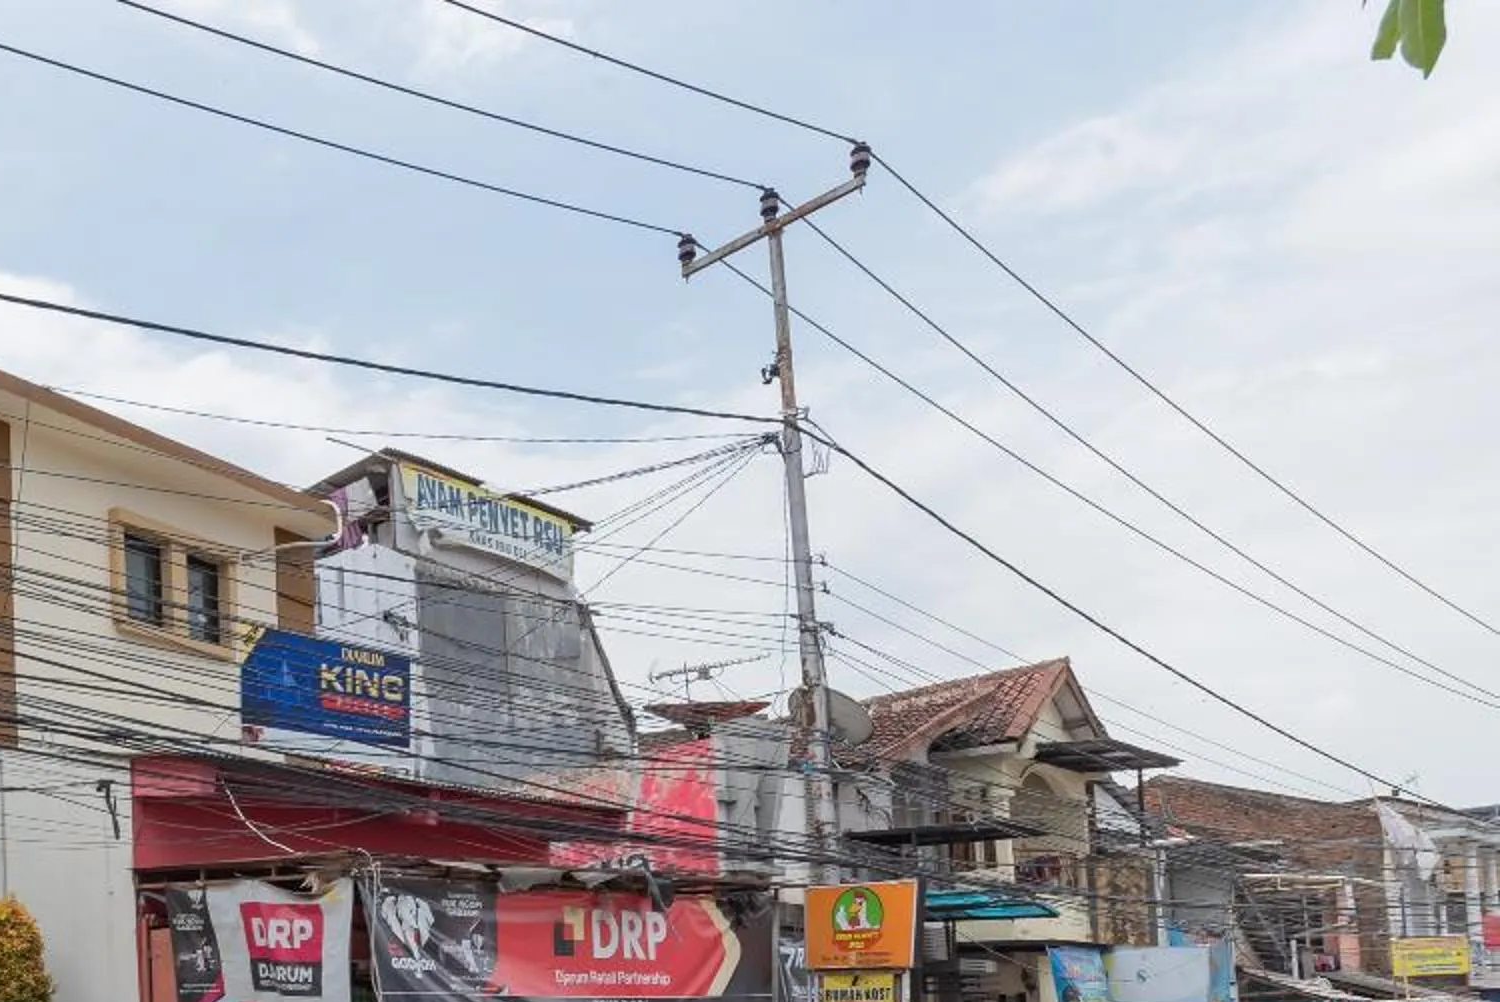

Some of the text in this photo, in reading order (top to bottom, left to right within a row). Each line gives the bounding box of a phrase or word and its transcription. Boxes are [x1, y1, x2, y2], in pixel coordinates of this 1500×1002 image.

[320, 662, 404, 701] KING
[251, 917, 313, 949] DRP
[591, 908, 667, 960] DRP
[617, 970, 671, 986] Partnership
